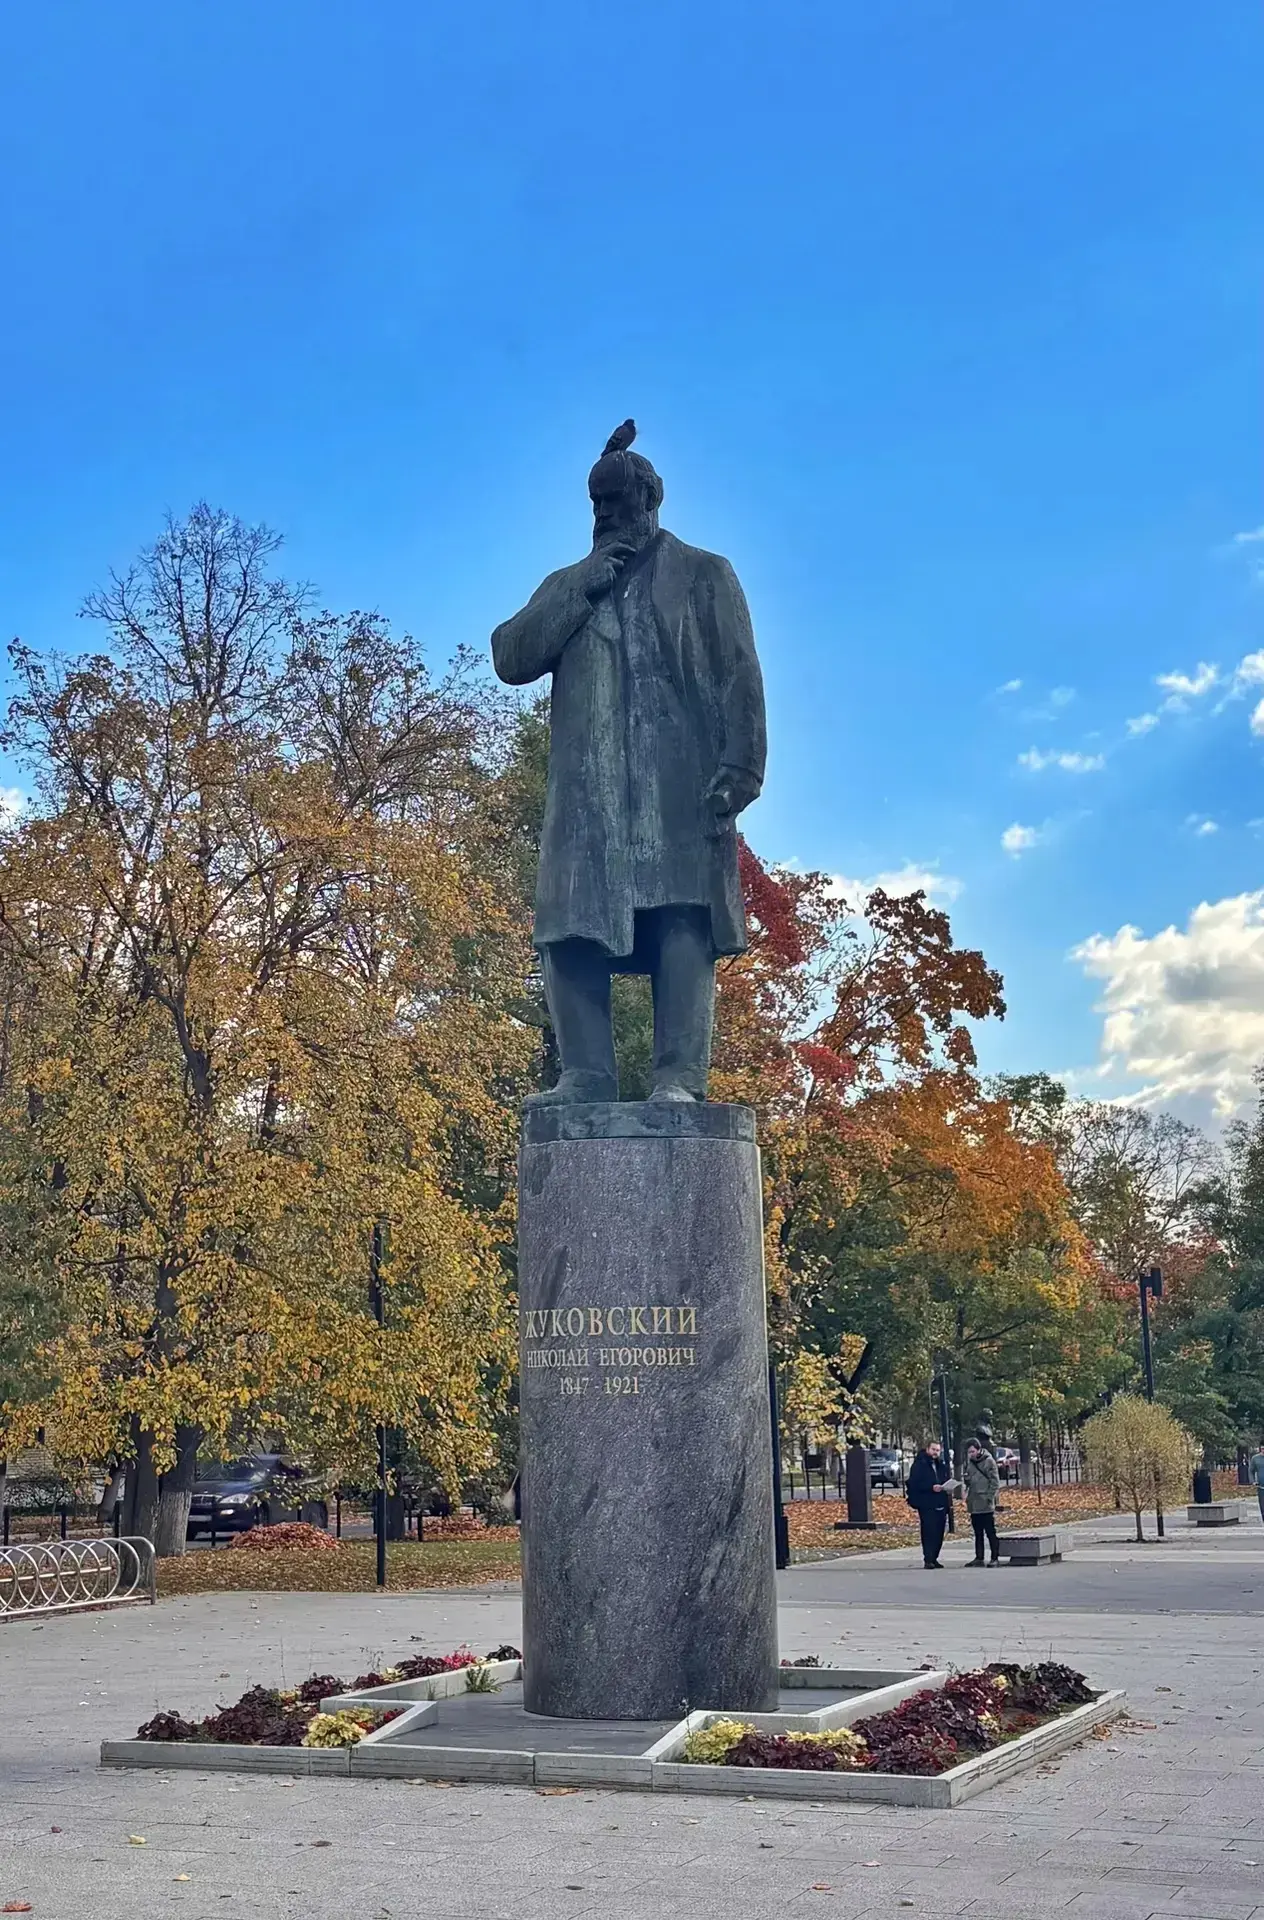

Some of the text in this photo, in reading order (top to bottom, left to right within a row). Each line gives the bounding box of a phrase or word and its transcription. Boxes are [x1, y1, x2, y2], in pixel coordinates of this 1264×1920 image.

[524, 1297, 699, 1339] ЖУКОВСКИЙ
[527, 1345, 696, 1368] НИКОЛАЙ ЕГОРОВИЧ
[559, 1377, 590, 1395] 1847
[604, 1376, 640, 1394] 1921
